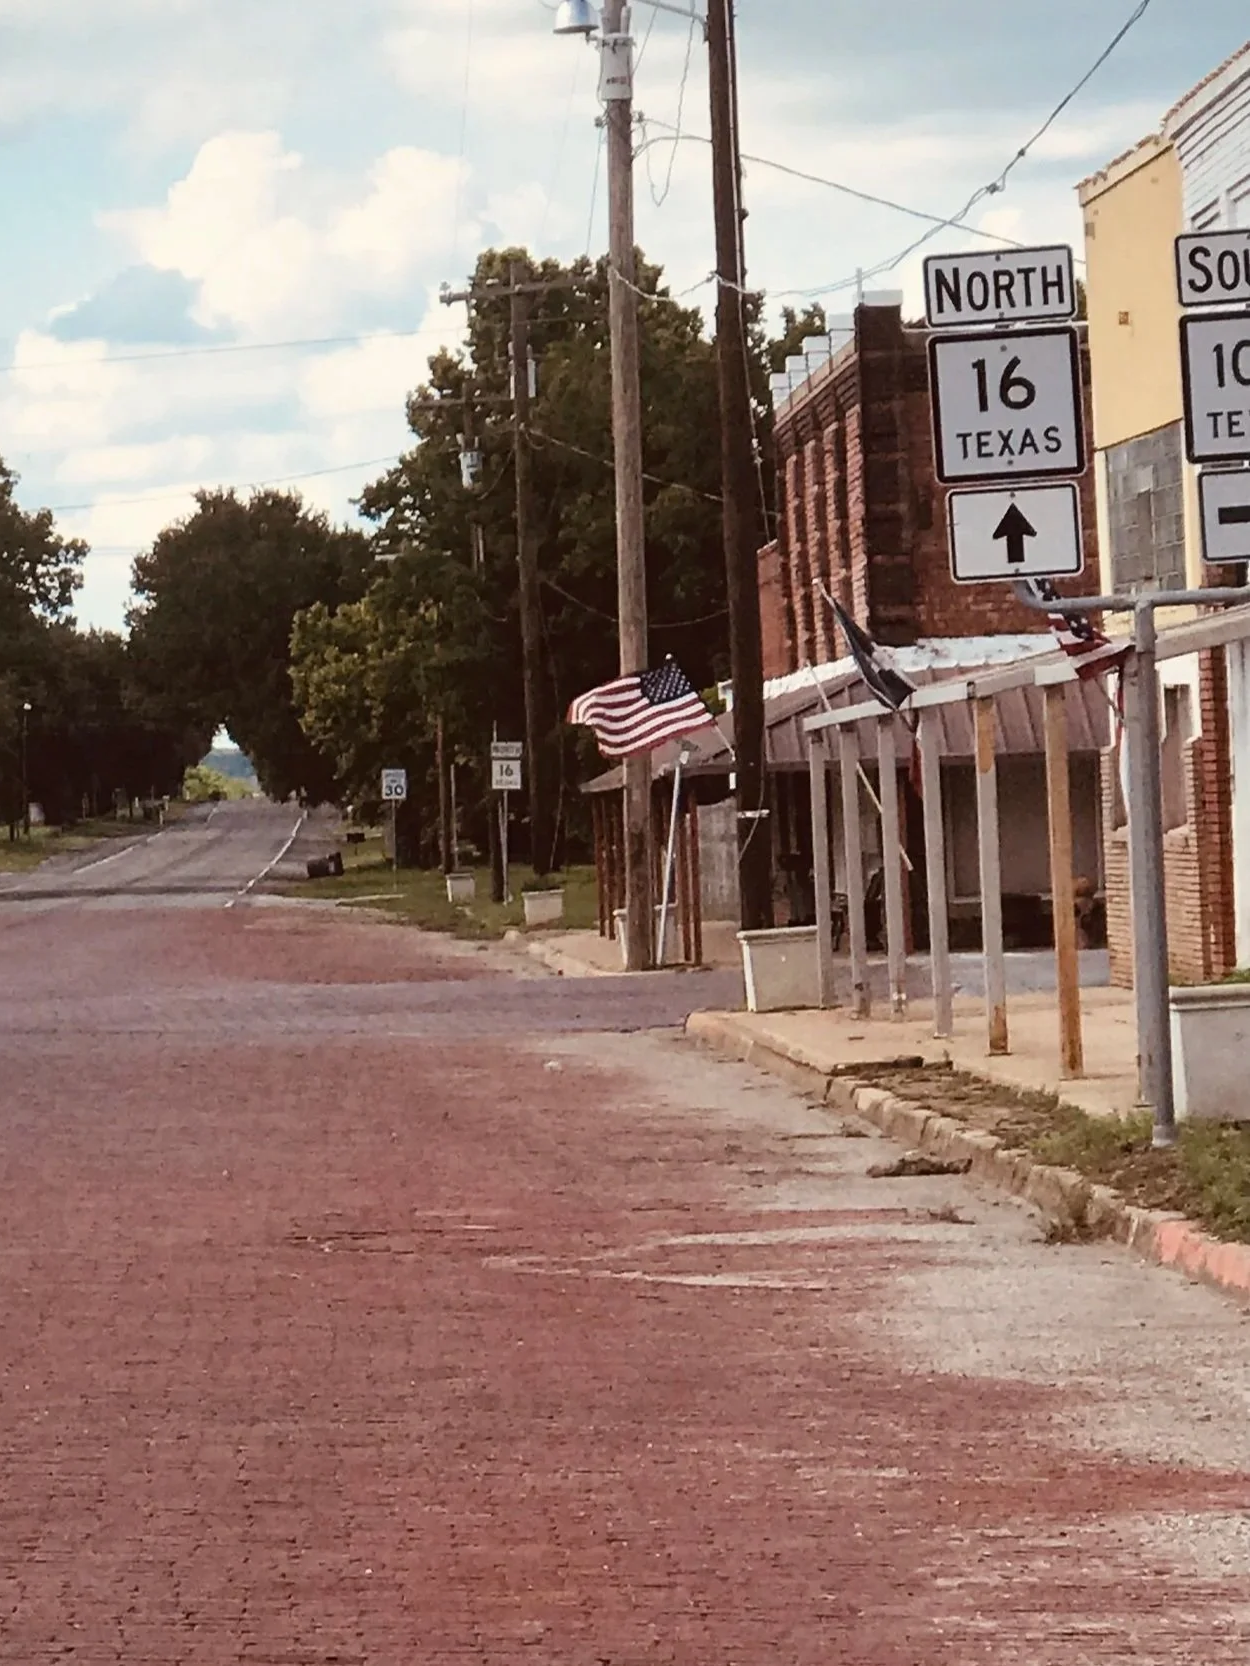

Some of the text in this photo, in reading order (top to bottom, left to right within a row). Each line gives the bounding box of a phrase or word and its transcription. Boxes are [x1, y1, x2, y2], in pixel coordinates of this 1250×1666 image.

[1188, 246, 1250, 293] SO
[935, 264, 1065, 313] NORTH
[972, 356, 1036, 413] 16
[1206, 409, 1250, 439] TE
[957, 426, 1062, 459] TEXAS
[499, 764, 514, 777] 16
[384, 785, 404, 797] 30
